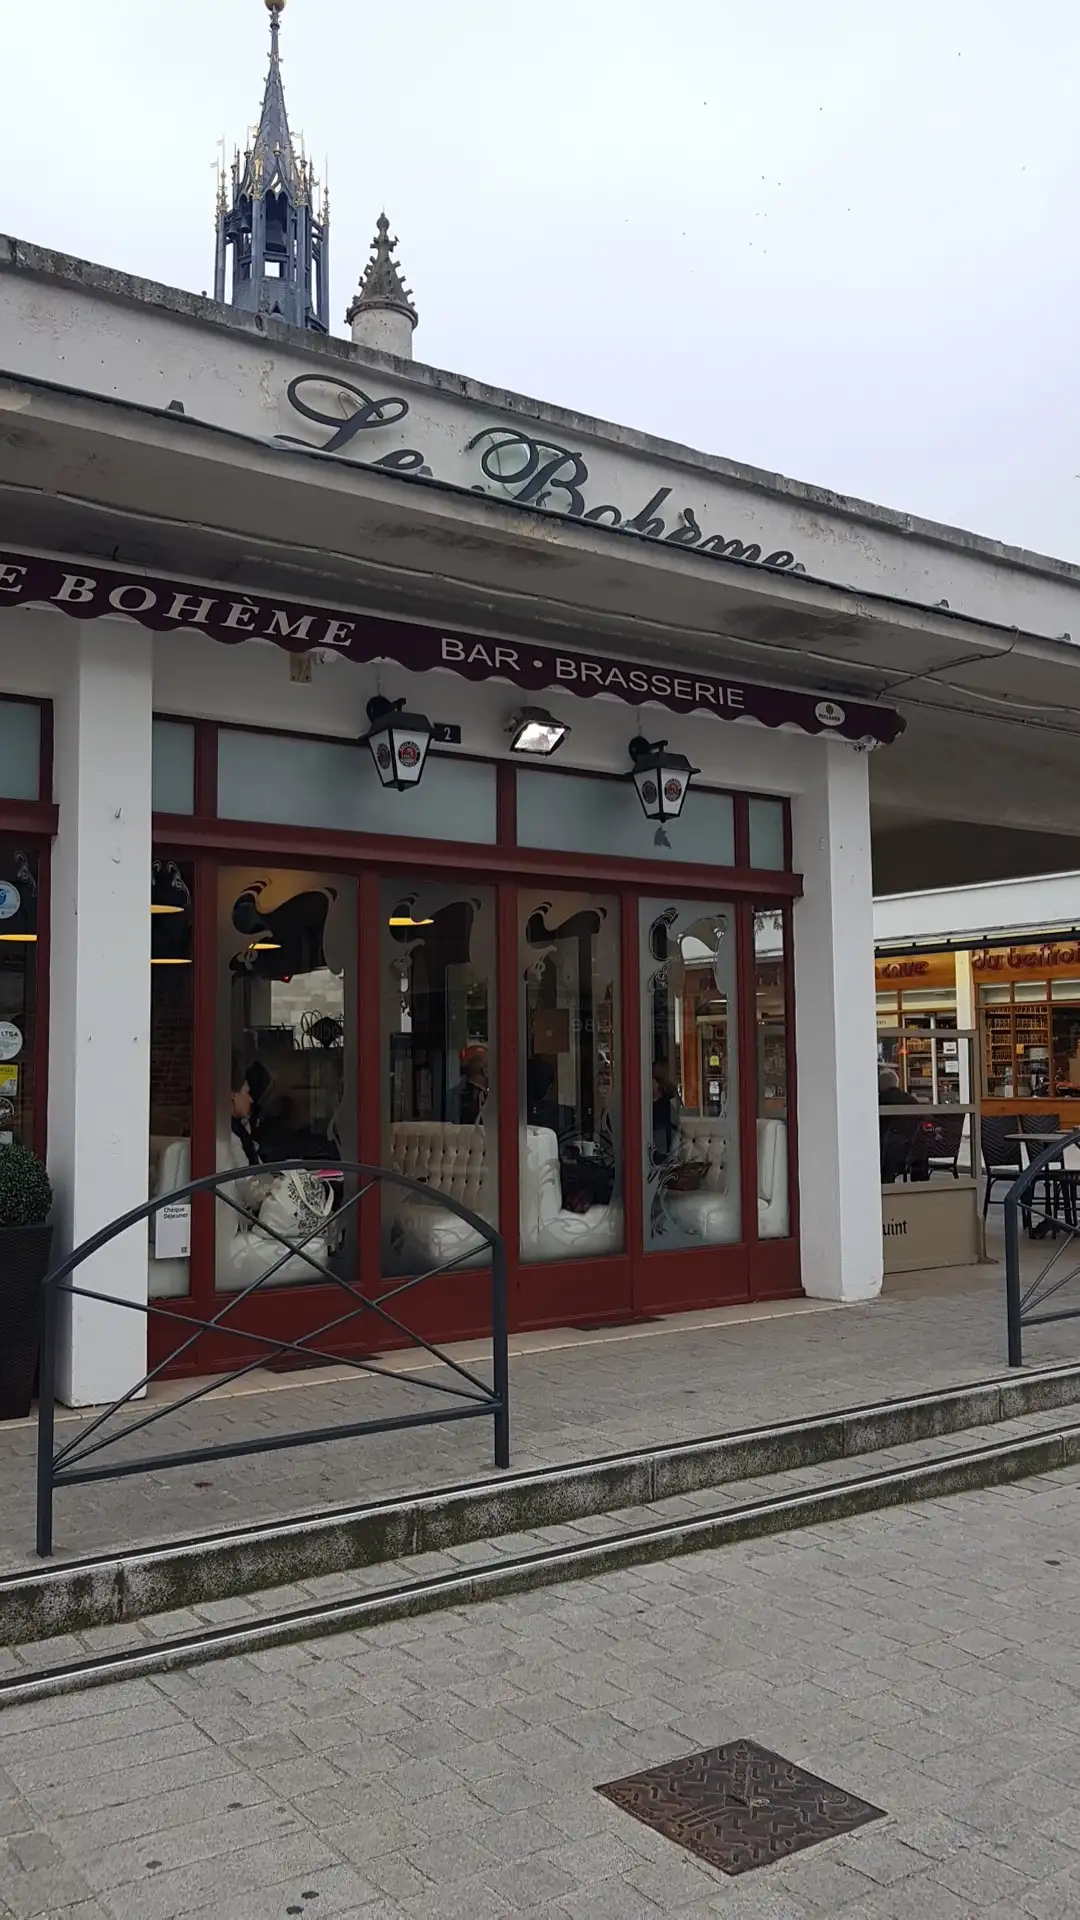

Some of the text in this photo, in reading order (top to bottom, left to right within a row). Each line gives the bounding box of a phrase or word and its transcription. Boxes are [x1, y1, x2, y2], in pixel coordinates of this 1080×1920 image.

[50, 573, 356, 647] BOHÈME
[441, 637, 745, 709] BAR BRASSERIE
[443, 726, 452, 741] 2
